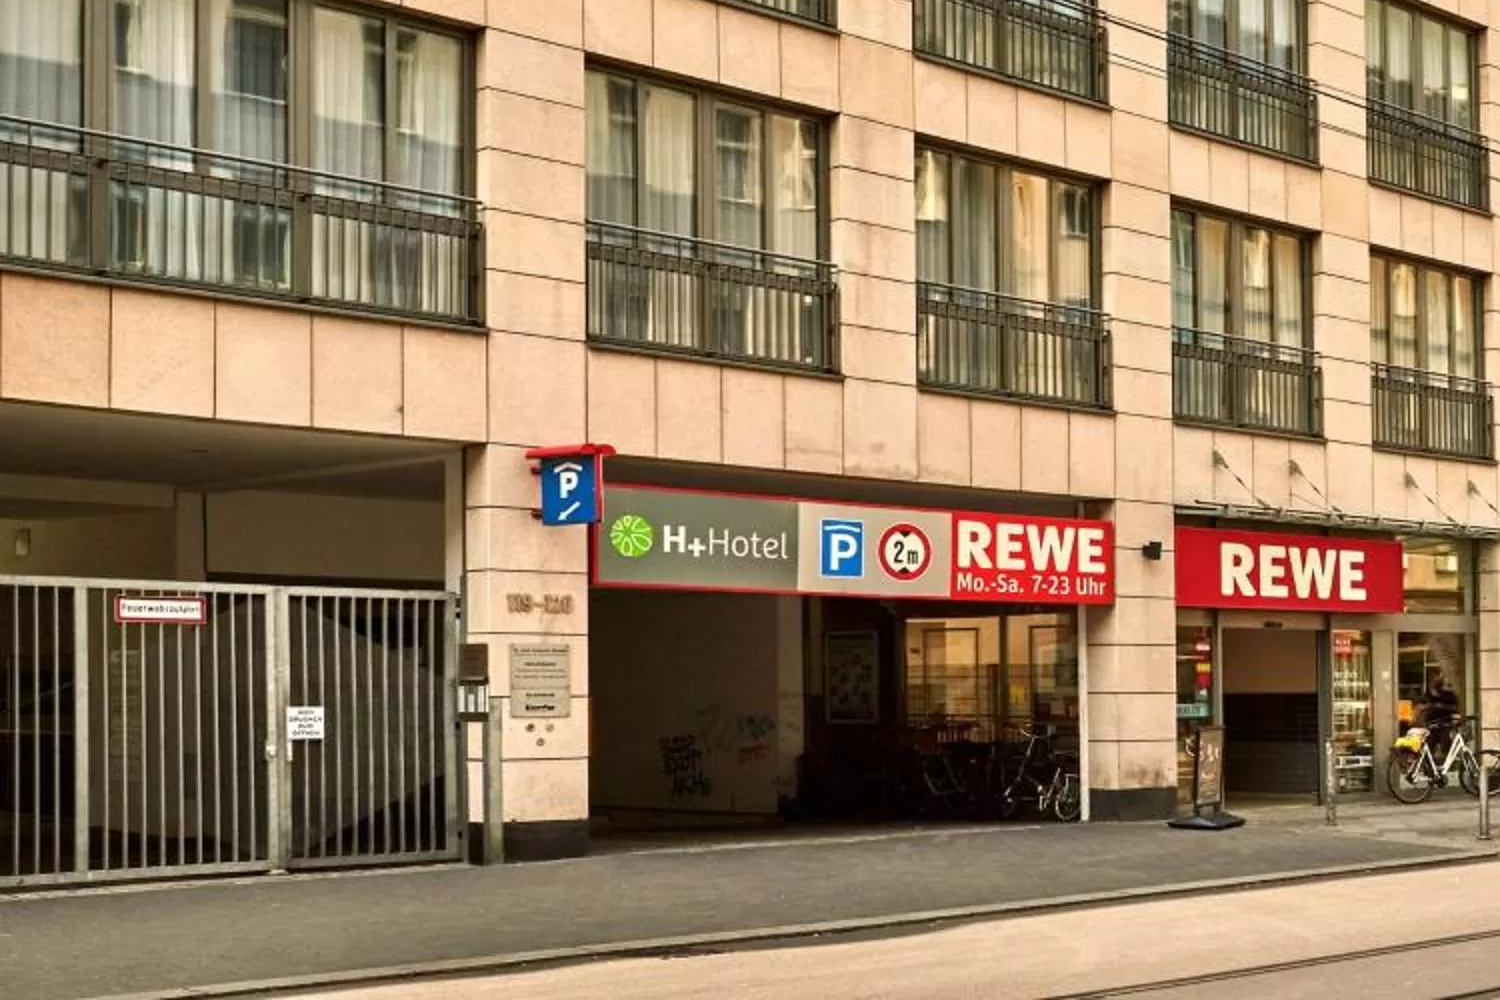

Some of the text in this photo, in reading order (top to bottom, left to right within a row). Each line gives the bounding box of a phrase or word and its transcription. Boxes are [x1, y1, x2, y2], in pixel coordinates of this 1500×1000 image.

[560, 471, 579, 498] P
[829, 533, 857, 571] P
[893, 541, 918, 565] 2 m
[957, 520, 1106, 574] REWE
[957, 573, 1106, 596] Mo.-Sa. 7-23 Uhr
[1220, 541, 1367, 601] REWE
